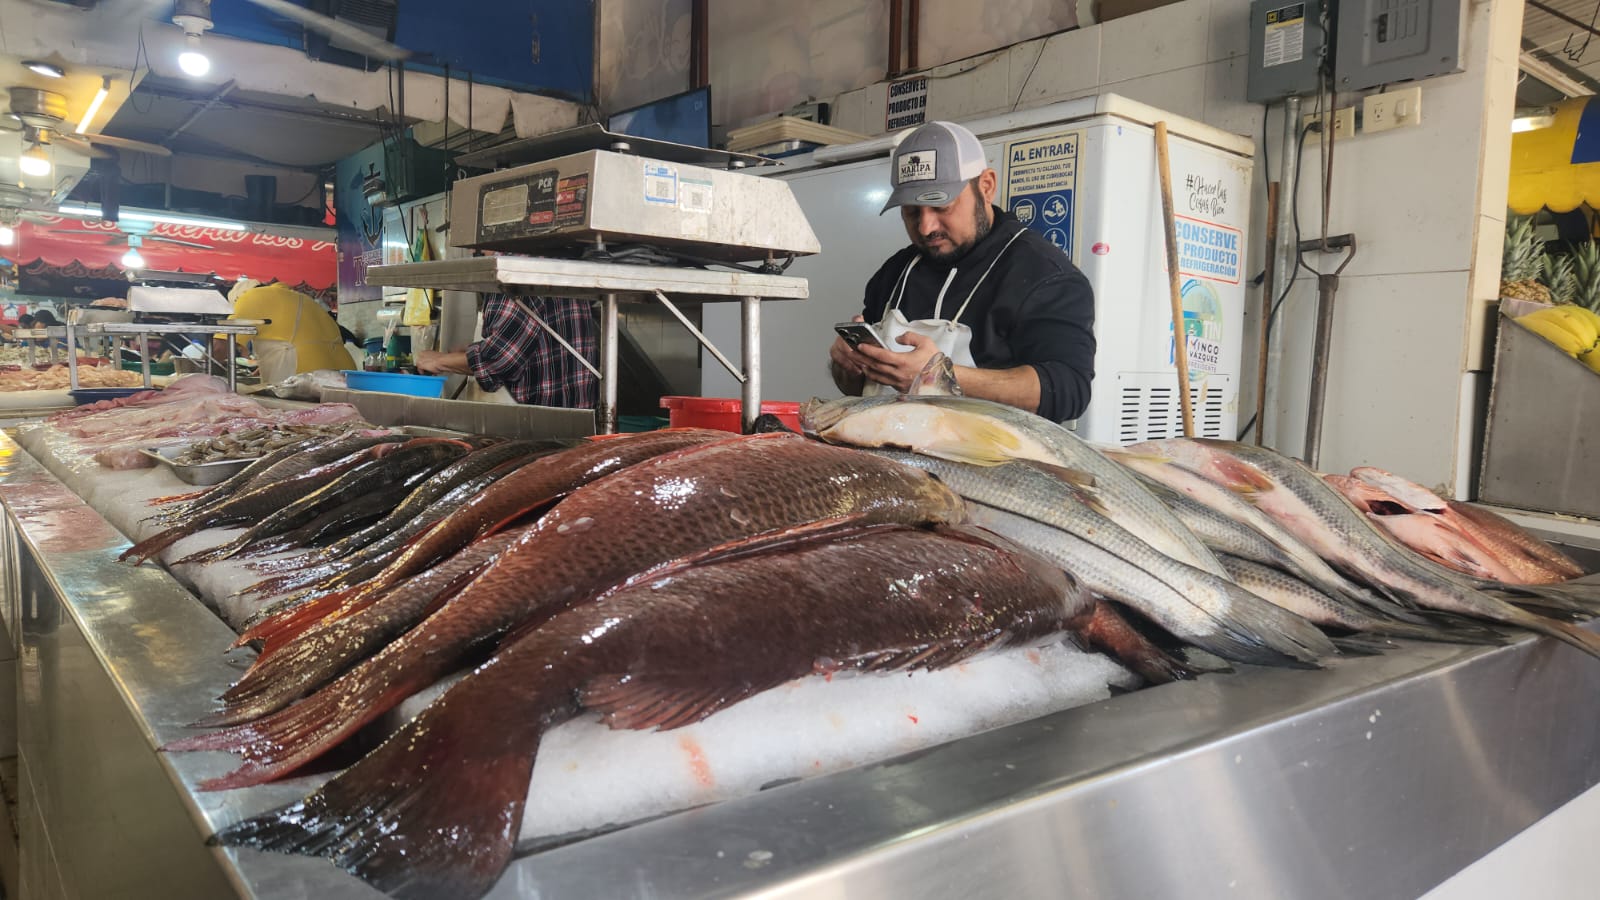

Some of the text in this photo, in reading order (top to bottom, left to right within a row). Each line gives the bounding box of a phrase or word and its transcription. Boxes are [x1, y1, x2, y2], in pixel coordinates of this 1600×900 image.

[890, 79, 926, 98] CONSERVE EL
[887, 94, 927, 115] PRODUCTO EN
[1013, 142, 1074, 162] AL ENTRAR:
[537, 177, 553, 190] PCR
[1175, 220, 1238, 251] CONSERVE
[1183, 242, 1238, 266] PRODUCTO
